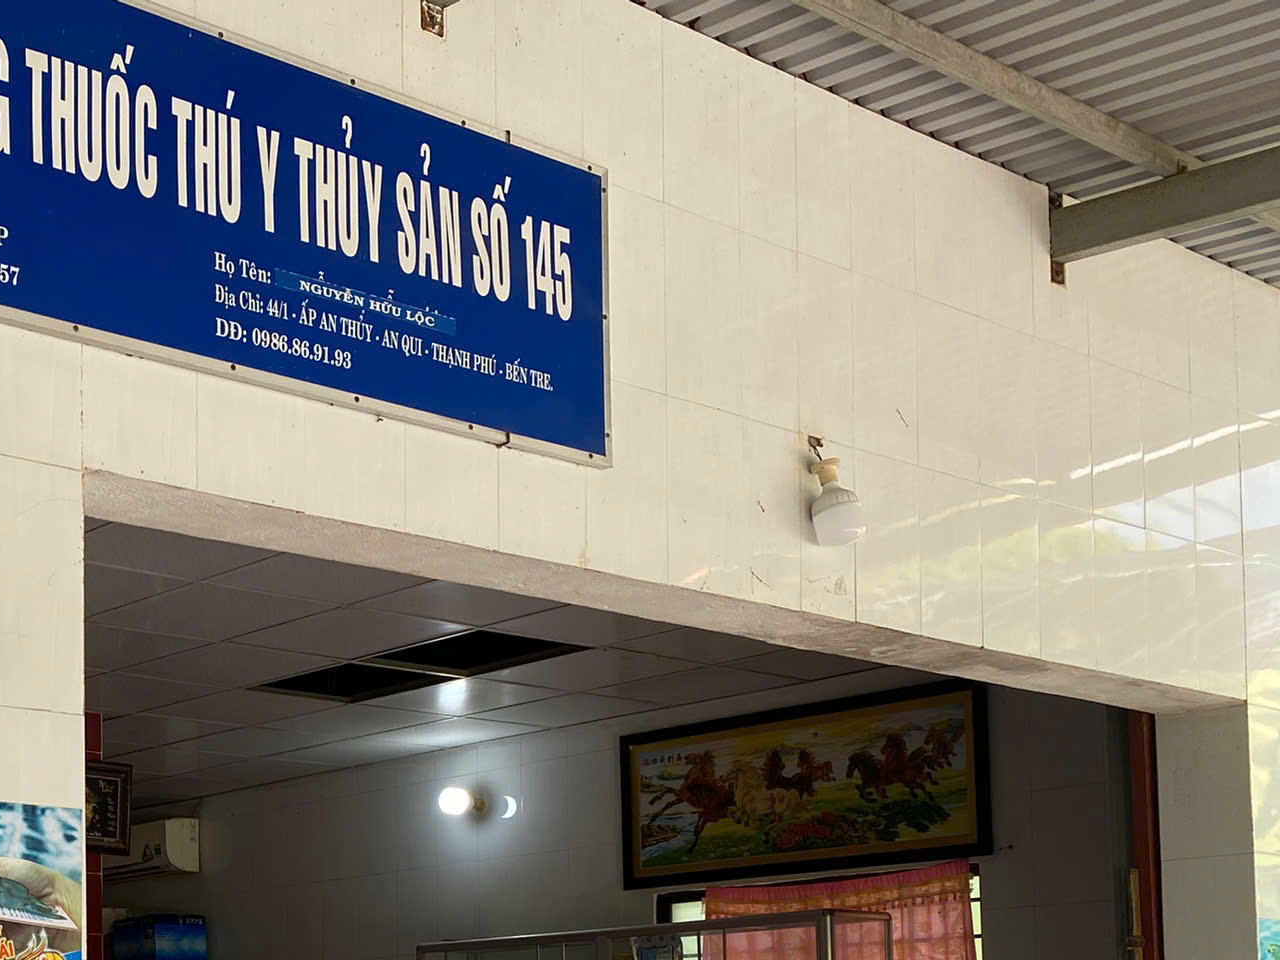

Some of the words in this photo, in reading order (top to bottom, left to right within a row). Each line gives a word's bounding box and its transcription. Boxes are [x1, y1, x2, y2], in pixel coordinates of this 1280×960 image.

[25, 45, 158, 199] THUỐC
[171, 90, 242, 224] THÚ
[256, 125, 280, 233] Y
[293, 115, 383, 263] THỦY
[395, 143, 463, 287] SẢN
[470, 176, 511, 302] SỐ
[520, 215, 572, 322] 145
[214, 252, 235, 275] Họ
[239, 258, 272, 285] Tên:
[214, 285, 236, 308] Địa
[239, 289, 264, 314] Chỉ:
[266, 298, 289, 321] 44/1
[299, 299, 317, 327] ẤP
[319, 311, 337, 333] AN
[340, 309, 373, 342] THỦY
[382, 329, 399, 351] AN
[401, 334, 422, 357] QUI
[431, 342, 471, 373] THẠNH
[473, 351, 497, 377] PHÚ
[505, 358, 528, 385] BẾN
[530, 370, 554, 392] TRE.
[252, 327, 352, 370] 0986.86.91.93
